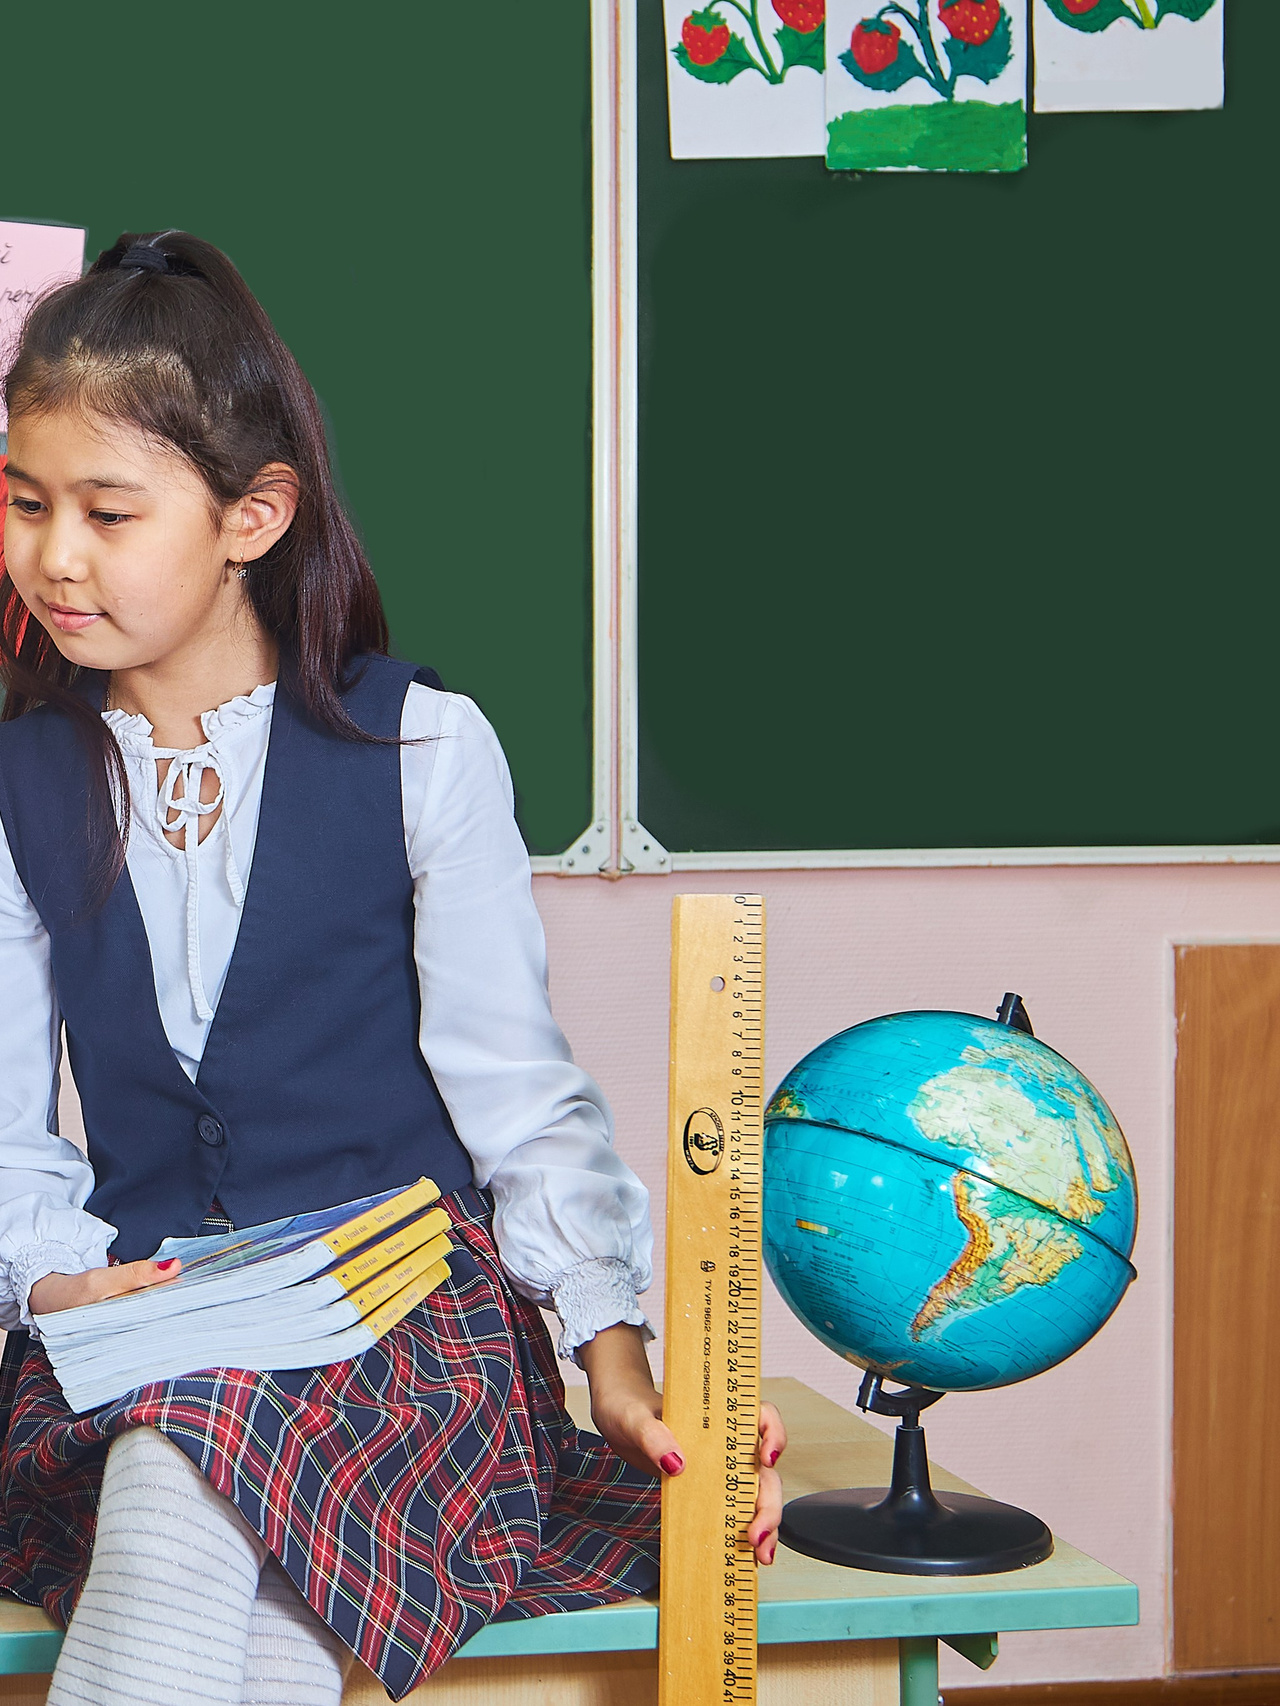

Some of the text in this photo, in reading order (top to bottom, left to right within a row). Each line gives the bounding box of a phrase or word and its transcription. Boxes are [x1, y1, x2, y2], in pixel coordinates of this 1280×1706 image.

[734, 895, 746, 904] 0
[733, 955, 743, 963] 3
[732, 1011, 743, 1019] 6
[731, 1050, 742, 1058] 8
[731, 1068, 742, 1076] 9
[731, 1090, 744, 1106] 10
[731, 1110, 741, 1121] 11
[730, 1130, 741, 1142] 12
[730, 1149, 741, 1162] 13
[730, 1168, 740, 1181] 14
[730, 1187, 740, 1200] 15
[730, 1206, 740, 1219] 16
[729, 1226, 740, 1238] 17
[729, 1245, 739, 1258] 18
[728, 1264, 739, 1277] 19
[728, 1280, 742, 1297] 20
[728, 1301, 739, 1314] 21
[727, 1320, 738, 1335] 22
[727, 1340, 738, 1354] 23
[727, 1359, 738, 1373] 24
[727, 1378, 738, 1393] 25
[727, 1397, 737, 1412] 26
[726, 1417, 737, 1432] 27
[726, 1437, 737, 1451] 28
[726, 1456, 737, 1470] 29
[725, 1474, 738, 1491] 30
[725, 1494, 736, 1508] 31
[725, 1514, 736, 1528] 32
[725, 1534, 736, 1548] 33
[724, 1553, 735, 1567] 34
[724, 1573, 735, 1587] 35
[724, 1592, 735, 1606] 36
[724, 1612, 734, 1627] 37
[724, 1631, 734, 1646] 38
[723, 1651, 734, 1665] 39
[723, 1669, 736, 1686] 40
[723, 1690, 733, 1703] 41
